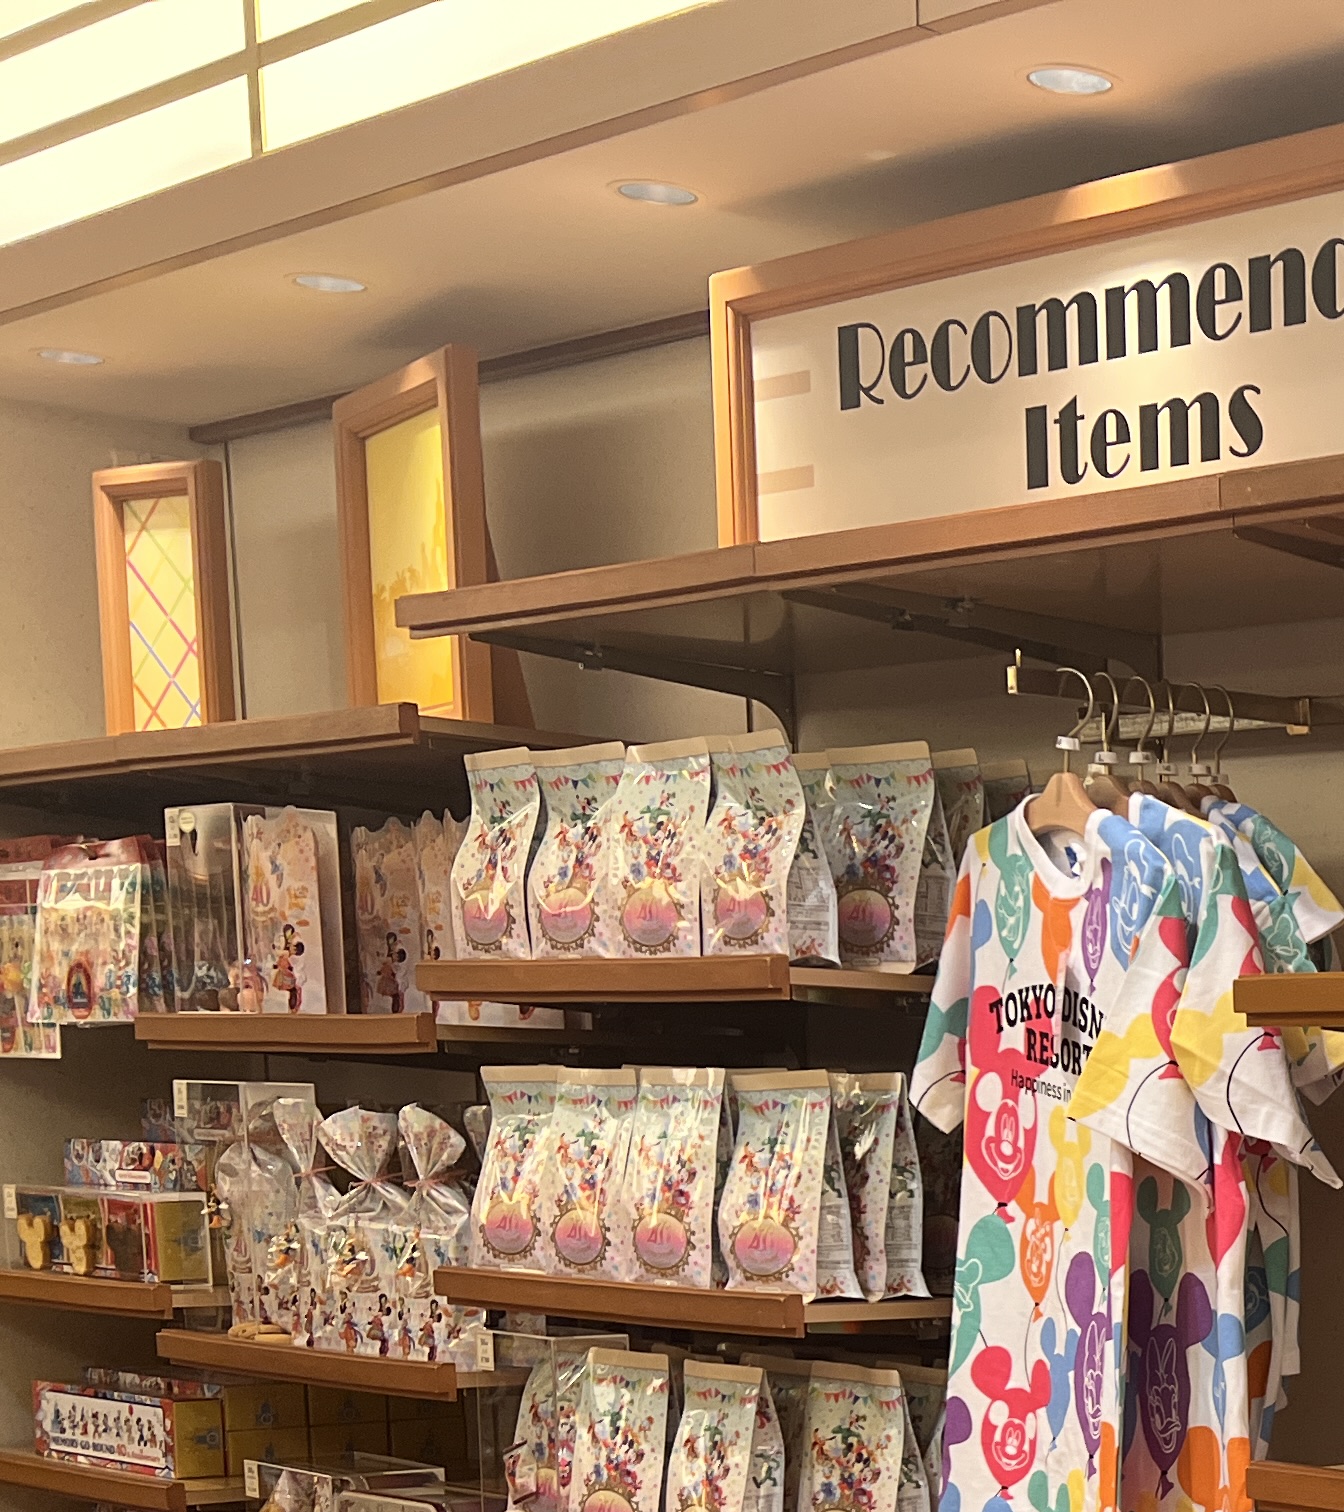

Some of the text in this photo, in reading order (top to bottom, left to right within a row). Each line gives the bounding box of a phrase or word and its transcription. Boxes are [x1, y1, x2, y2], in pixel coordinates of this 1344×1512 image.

[1024, 383, 1264, 490] Items
[989, 983, 1104, 1040] TOKYO DISN
[1011, 1068, 1062, 1101] Happiness
